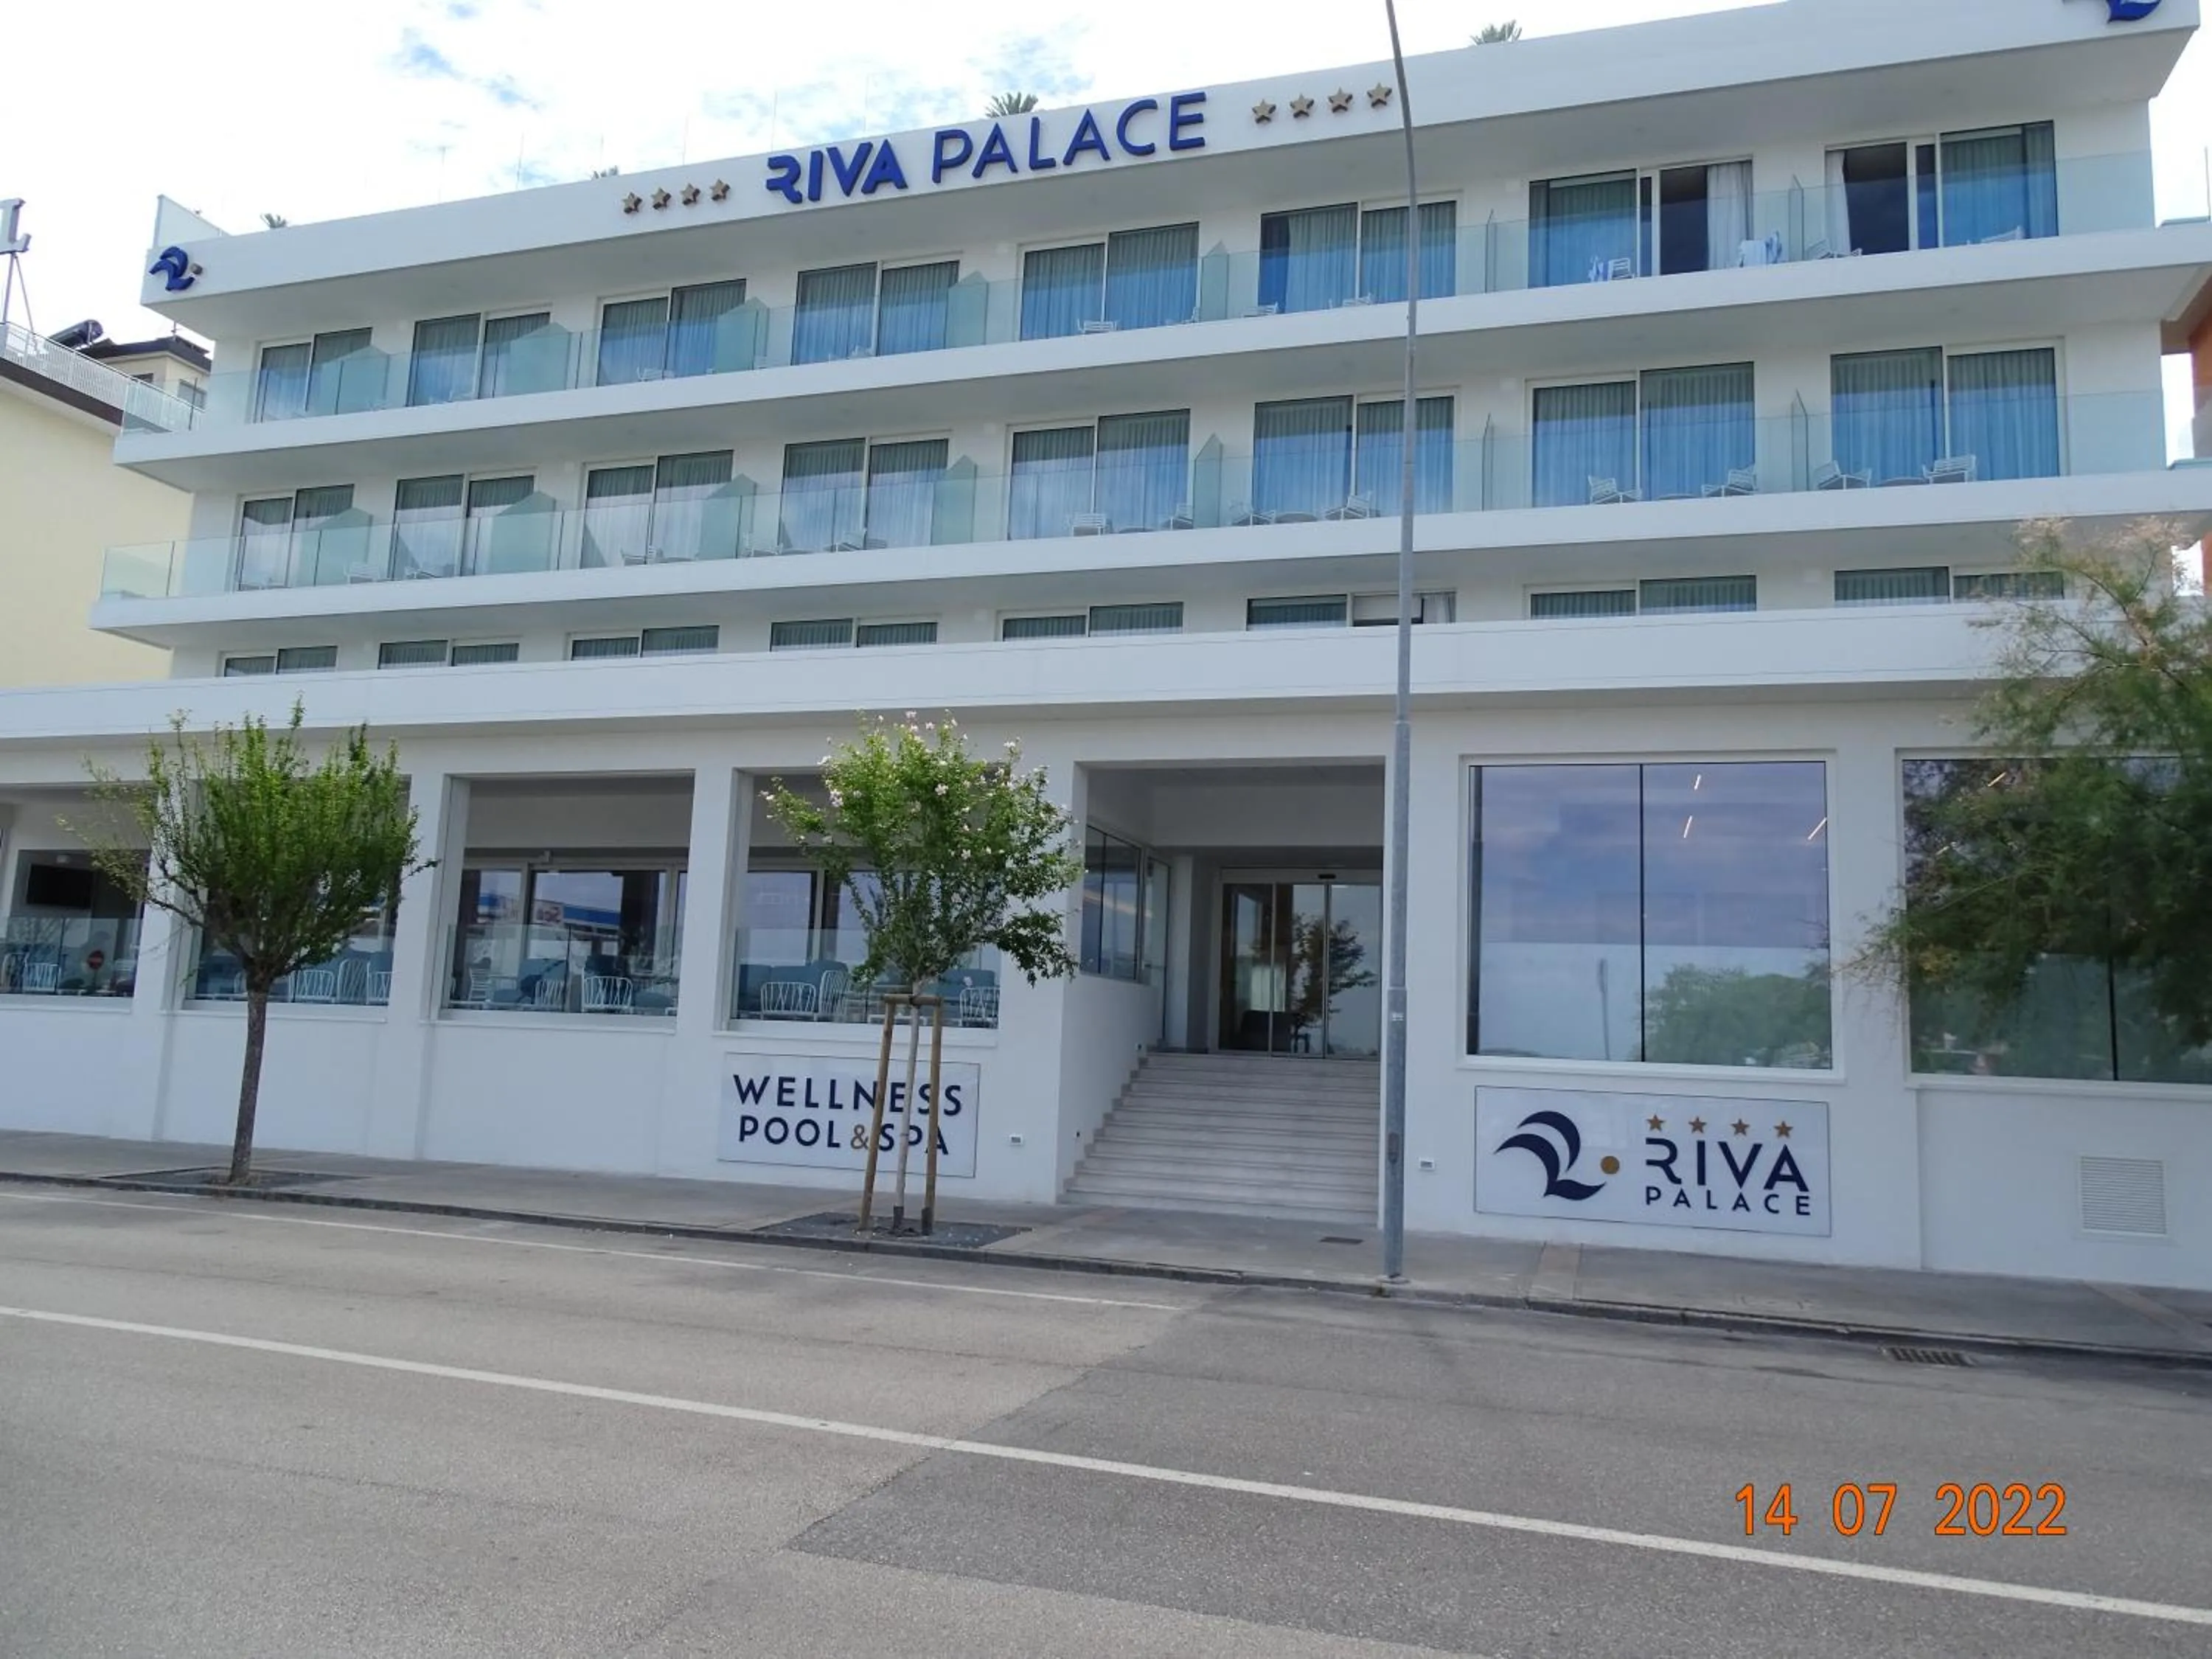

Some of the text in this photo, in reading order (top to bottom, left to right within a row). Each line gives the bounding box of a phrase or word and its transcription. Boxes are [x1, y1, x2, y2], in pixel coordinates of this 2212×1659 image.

[765, 91, 1207, 204] RIVA PALACE
[733, 1074, 962, 1116] WELLNESS
[739, 1116, 841, 1148] POOL
[1645, 1138, 1809, 1193] RIVA
[1645, 1186, 1811, 1217] PALACE
